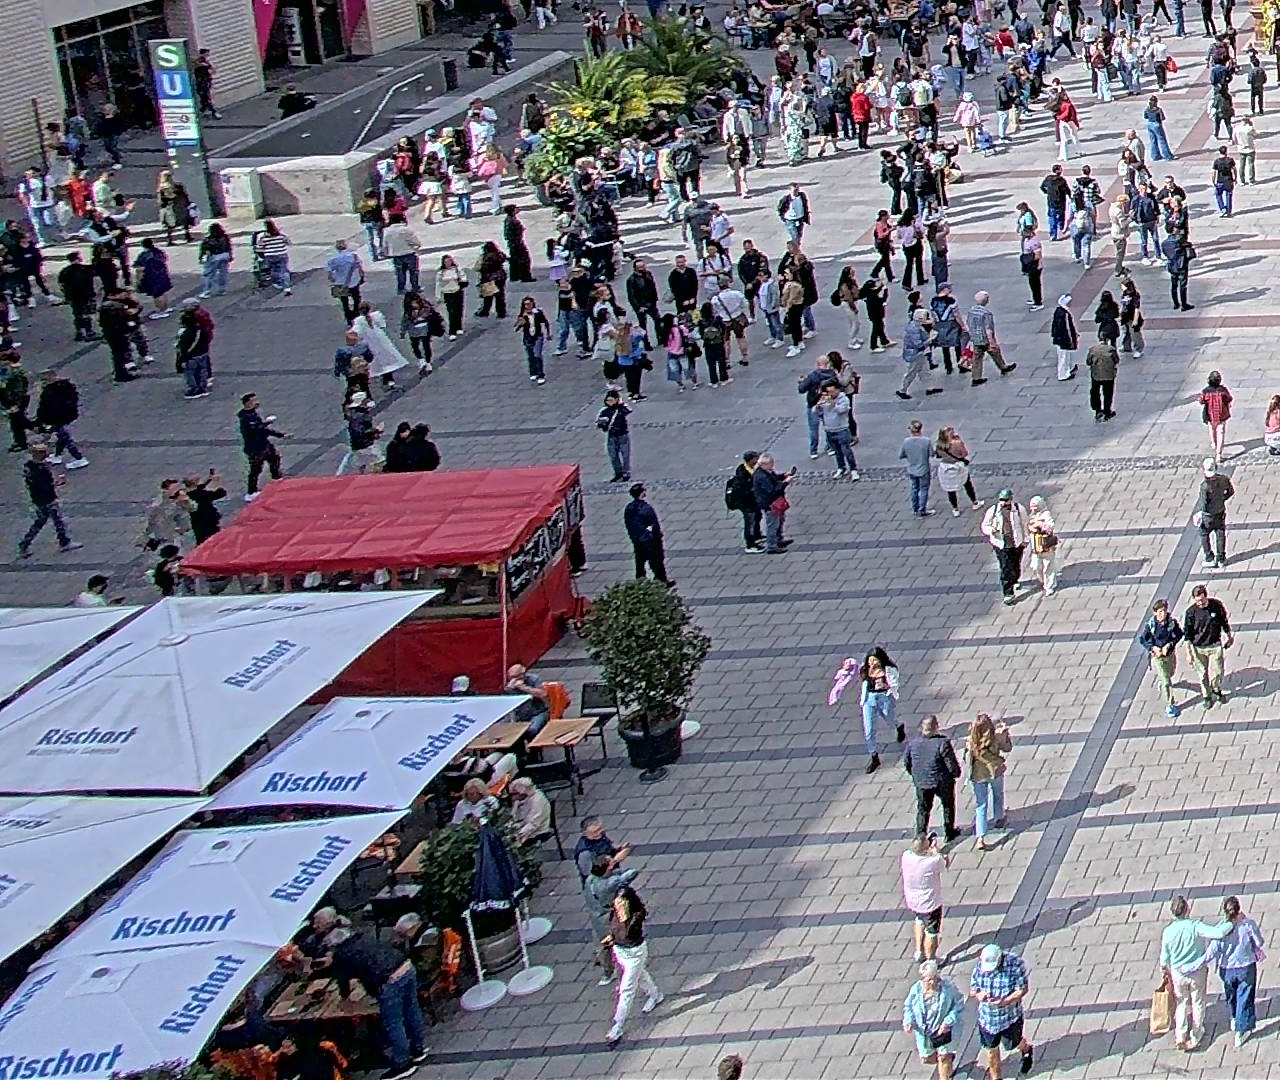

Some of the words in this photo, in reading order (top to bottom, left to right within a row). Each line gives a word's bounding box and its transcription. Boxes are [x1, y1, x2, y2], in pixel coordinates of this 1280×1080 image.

[157, 44, 179, 67] S
[161, 74, 183, 96] U
[221, 638, 297, 688] Rischart
[36, 726, 139, 745] Rischart
[397, 712, 477, 771] Rischart
[260, 770, 368, 793] Rischart
[268, 834, 352, 903] Rischart
[111, 908, 237, 941] Rischart
[158, 953, 246, 1034] Rischart
[0, 1043, 125, 1080] Rischart
